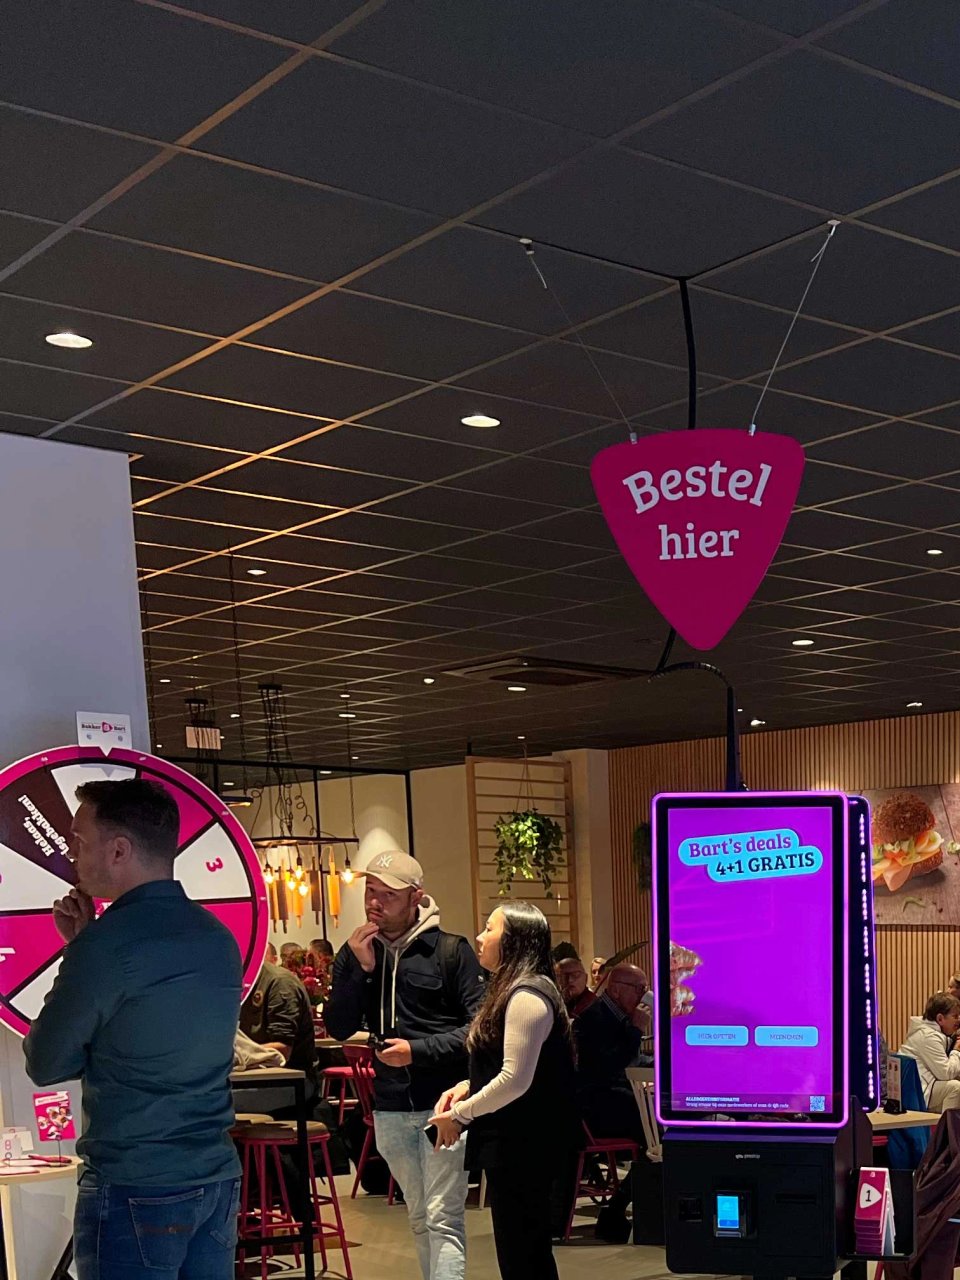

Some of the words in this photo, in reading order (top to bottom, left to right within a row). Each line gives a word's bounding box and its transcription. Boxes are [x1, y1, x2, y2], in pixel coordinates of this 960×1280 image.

[623, 460, 773, 514] Bestel
[658, 524, 740, 561] hier
[18, 794, 75, 863] isgebakken!
[23, 816, 55, 857] Helaas,
[688, 838, 743, 858] Bart's
[746, 833, 792, 852] deals
[206, 857, 223, 872] 3
[376, 854, 392, 868] NY
[716, 859, 744, 876] 4+1
[747, 852, 816, 874] GRATIS
[865, 1190, 871, 1202] 1
